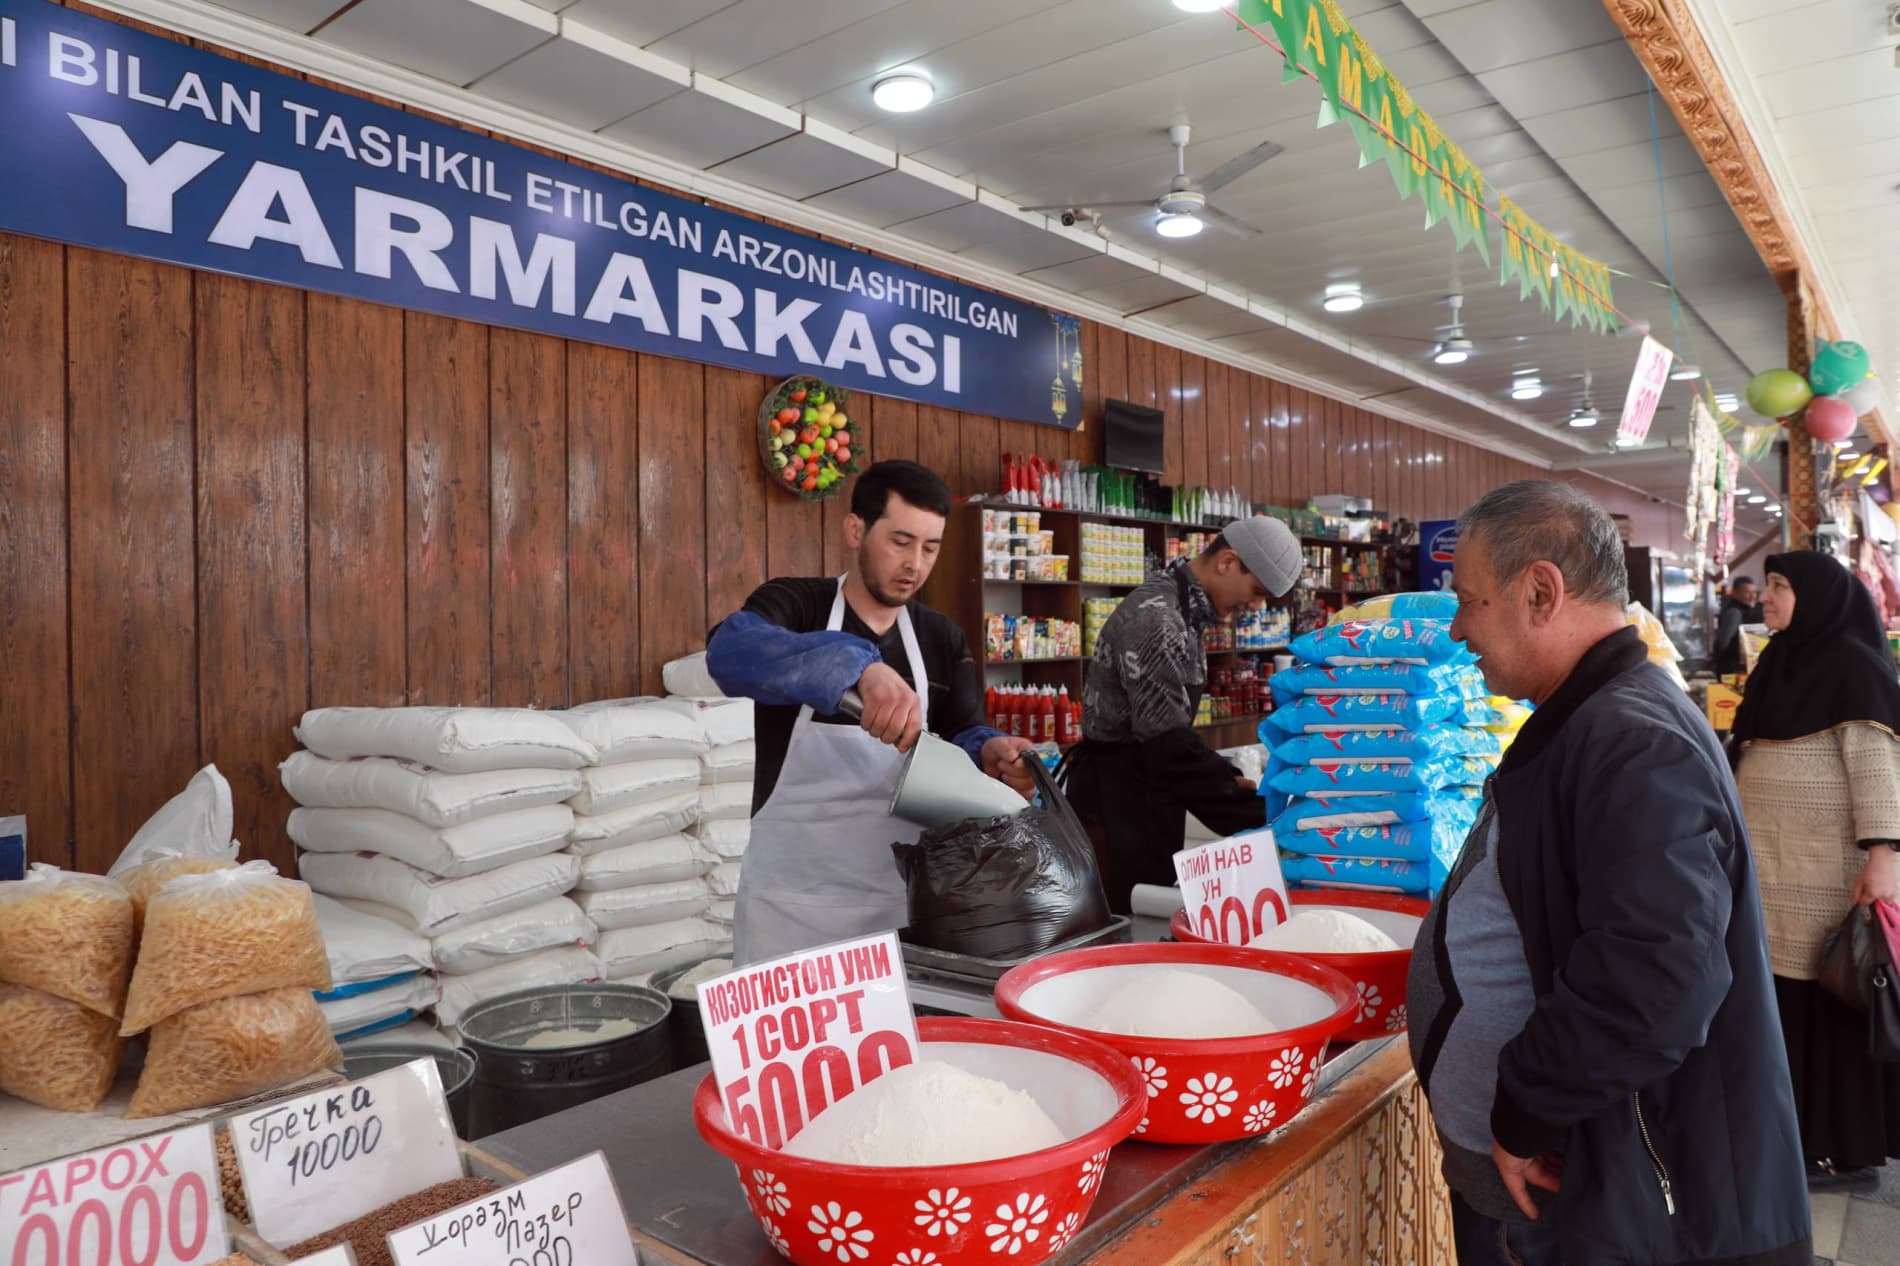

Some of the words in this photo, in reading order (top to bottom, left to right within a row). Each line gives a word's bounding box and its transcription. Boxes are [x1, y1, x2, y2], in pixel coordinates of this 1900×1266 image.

[48, 32, 261, 133] BILAN
[282, 100, 511, 202] TASHKIL
[526, 172, 702, 253] ETILGAN
[712, 229, 1018, 338] ARZONLASHTIRILGAN
[66, 112, 961, 393] YARMARKASI
[1181, 848, 1210, 881] ОЛИЙ
[1214, 844, 1253, 871] НАВ
[1202, 877, 1222, 902] УН
[705, 954, 836, 1026] КОЗОГИСТОН
[838, 942, 892, 986] УНИ
[732, 1023, 751, 1070] 1
[755, 989, 865, 1060] СОРТ
[250, 1086, 376, 1162] Гречка
[288, 1115, 382, 1186] 10000
